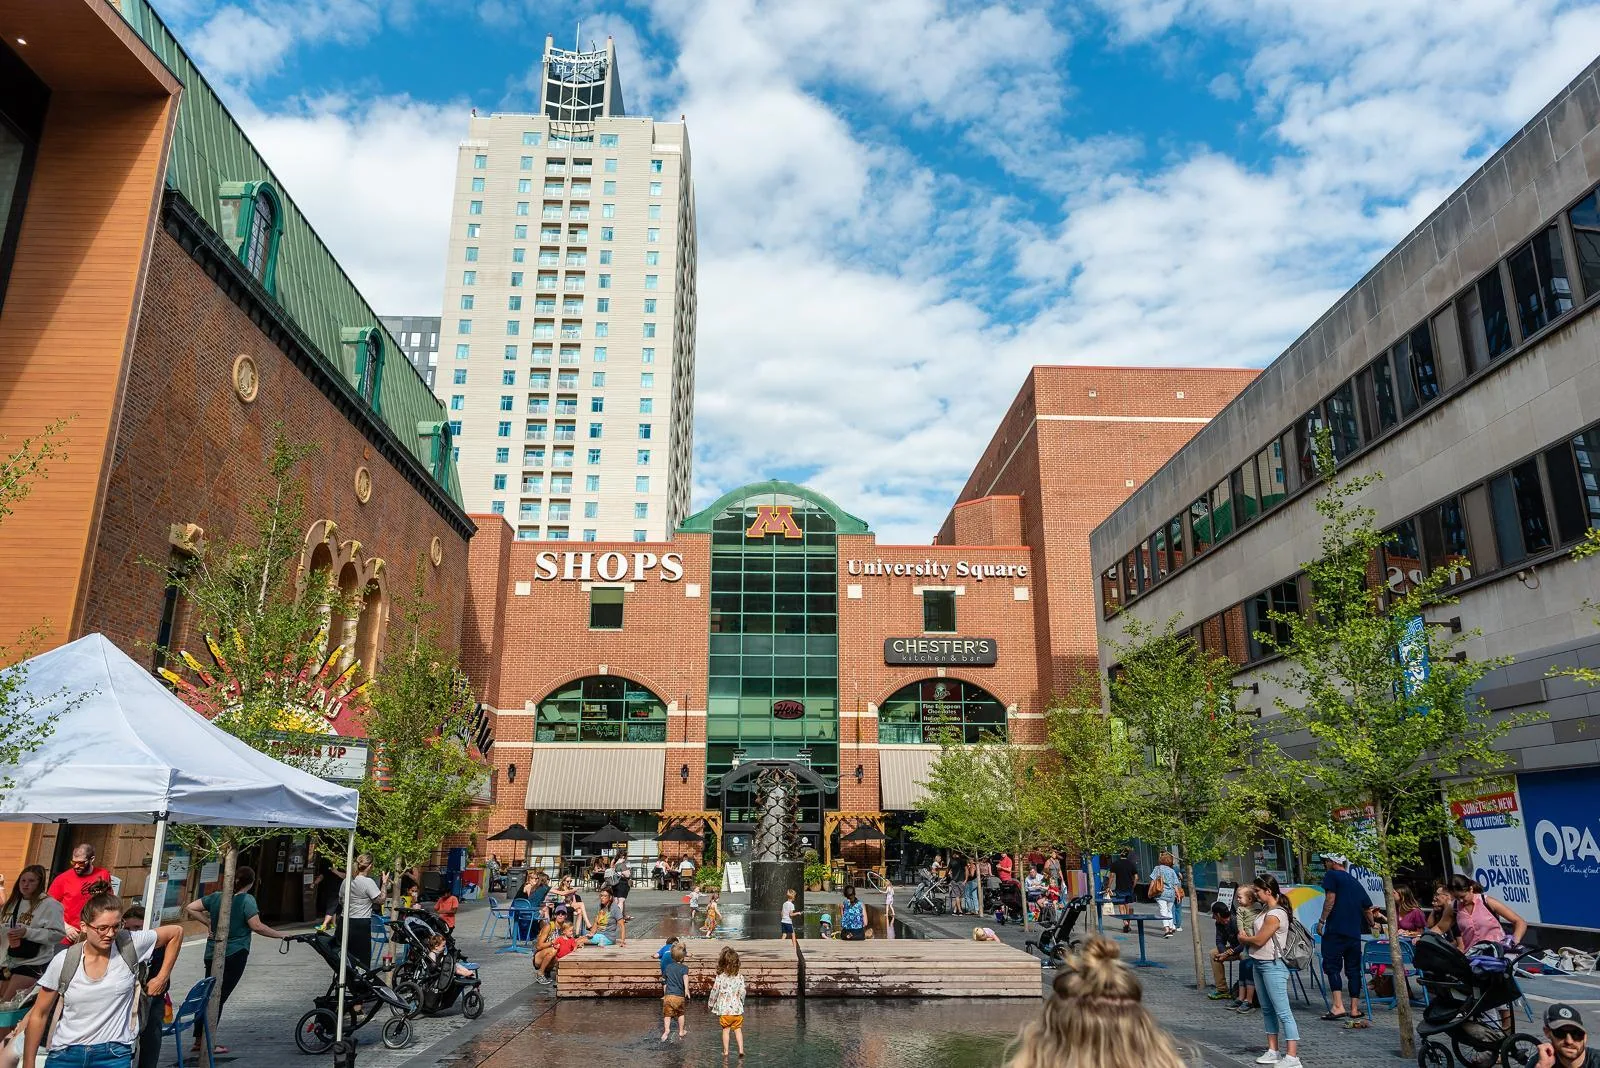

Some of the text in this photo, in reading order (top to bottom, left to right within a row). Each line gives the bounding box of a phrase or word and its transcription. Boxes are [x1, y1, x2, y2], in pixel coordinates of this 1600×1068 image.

[746, 505, 803, 539] M
[534, 551, 684, 582] SHOPS
[847, 558, 1028, 581] University Square
[893, 640, 989, 654] CHESTER'S
[902, 654, 981, 662] kitchen & bar
[328, 745, 347, 759] UP
[1498, 797, 1513, 811] NEW
[1472, 817, 1483, 828] OUR
[1488, 854, 1519, 867] WE'LL BE
[1475, 868, 1530, 892] OPANING
[1502, 887, 1531, 903] SOON!
